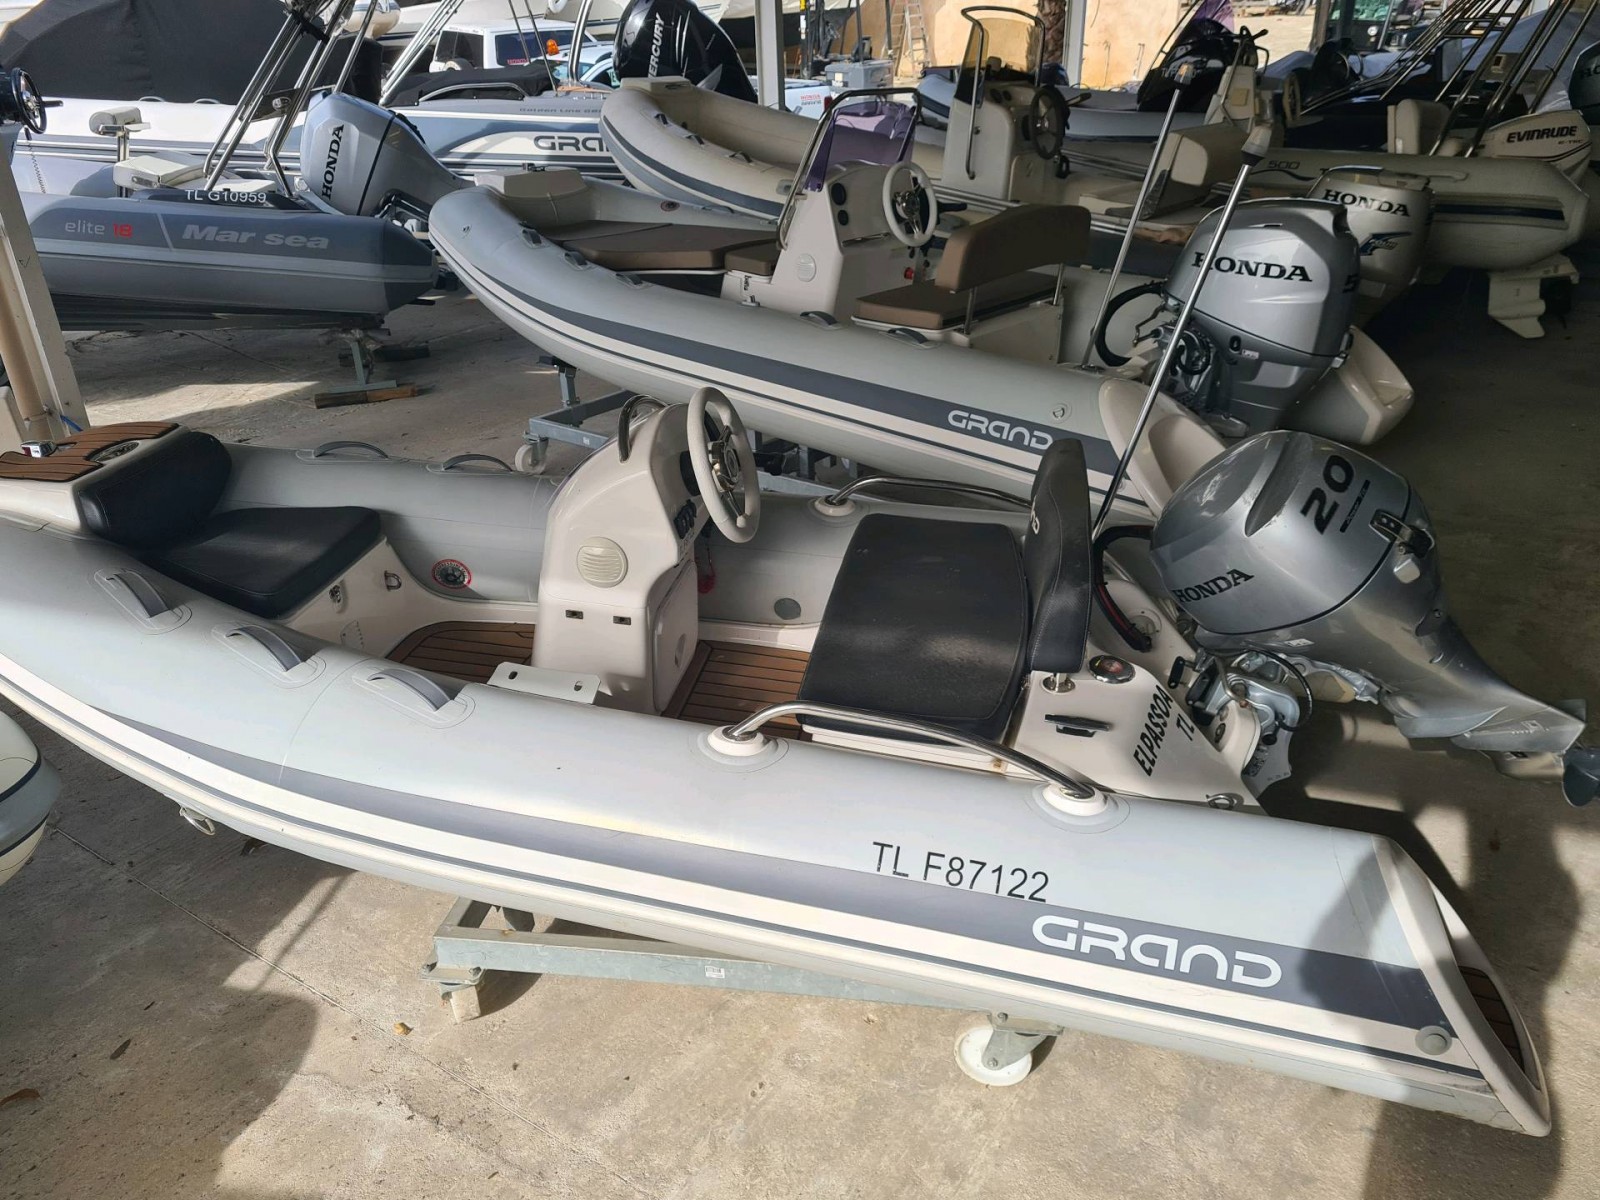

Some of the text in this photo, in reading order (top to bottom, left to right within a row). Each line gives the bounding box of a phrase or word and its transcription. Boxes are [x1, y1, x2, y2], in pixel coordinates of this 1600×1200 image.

[533, 136, 609, 152] GRA
[1506, 126, 1578, 143] EVINRUDE
[321, 124, 345, 200] HONDA
[1268, 160, 1300, 170] 500
[185, 189, 267, 204] TL G10959
[1322, 189, 1410, 217] HONDA
[65, 219, 133, 238] elite 18
[182, 224, 330, 249] Mar sea
[947, 409, 1053, 450] GRAND
[1300, 454, 1355, 535] 20
[1171, 568, 1255, 603] HONDA
[1133, 684, 1174, 777] ELPASSOA
[1176, 713, 1195, 741] TL
[872, 841, 1050, 903] TL F87122
[1031, 914, 1283, 988] GRAND
